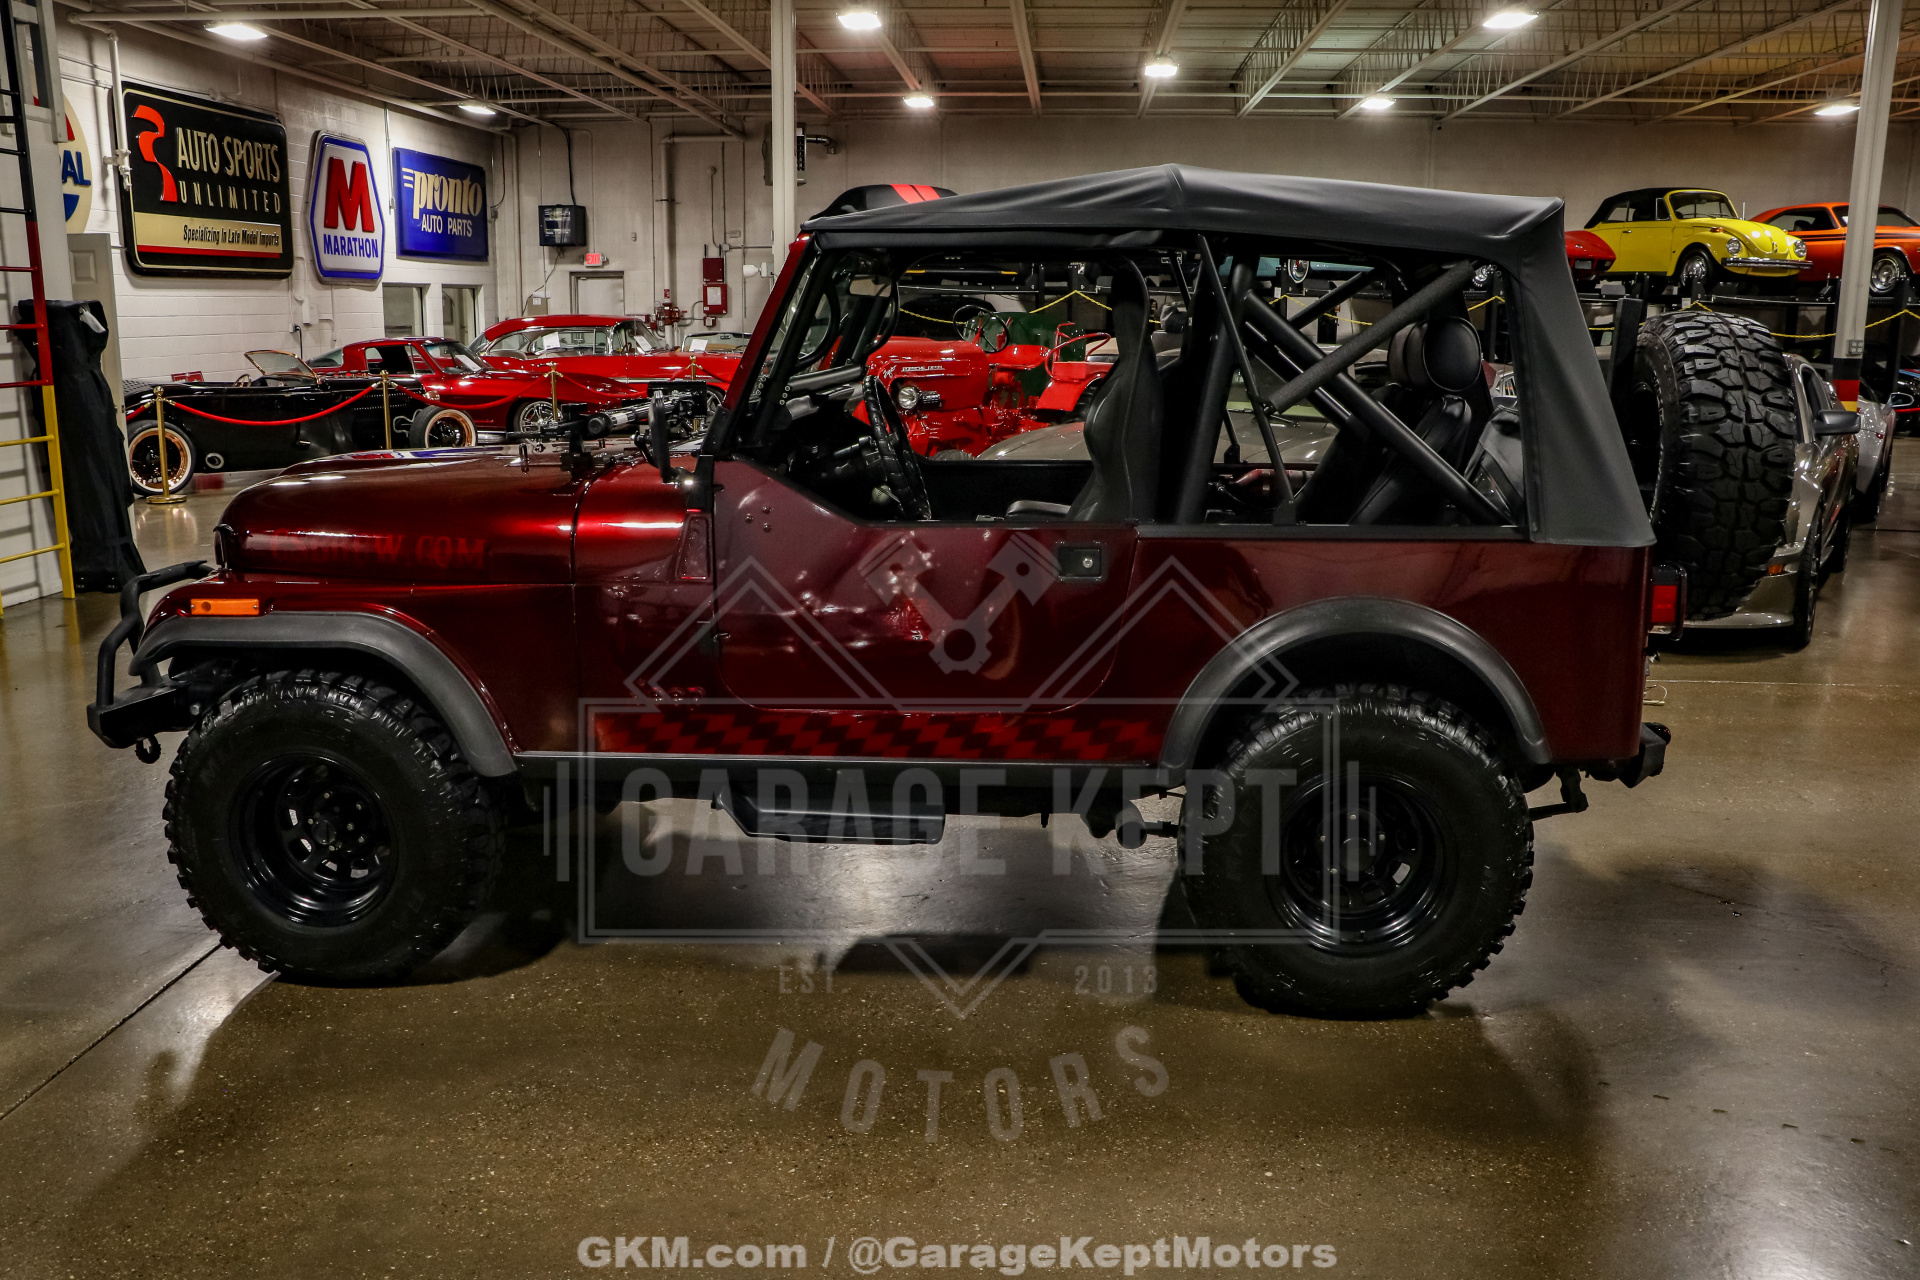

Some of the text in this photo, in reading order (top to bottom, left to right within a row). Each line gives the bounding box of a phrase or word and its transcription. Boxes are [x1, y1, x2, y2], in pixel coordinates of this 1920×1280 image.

[60, 149, 92, 186] AL
[177, 127, 281, 183] AUTO SPORTS
[178, 180, 281, 214] UNLIMITED
[411, 170, 483, 219] pronto
[183, 224, 280, 248] Specializing In Late Model Imports
[421, 213, 473, 238] AUTO PARTS
[323, 233, 379, 258] MARATHON
[586, 253, 600, 265] EXIT
